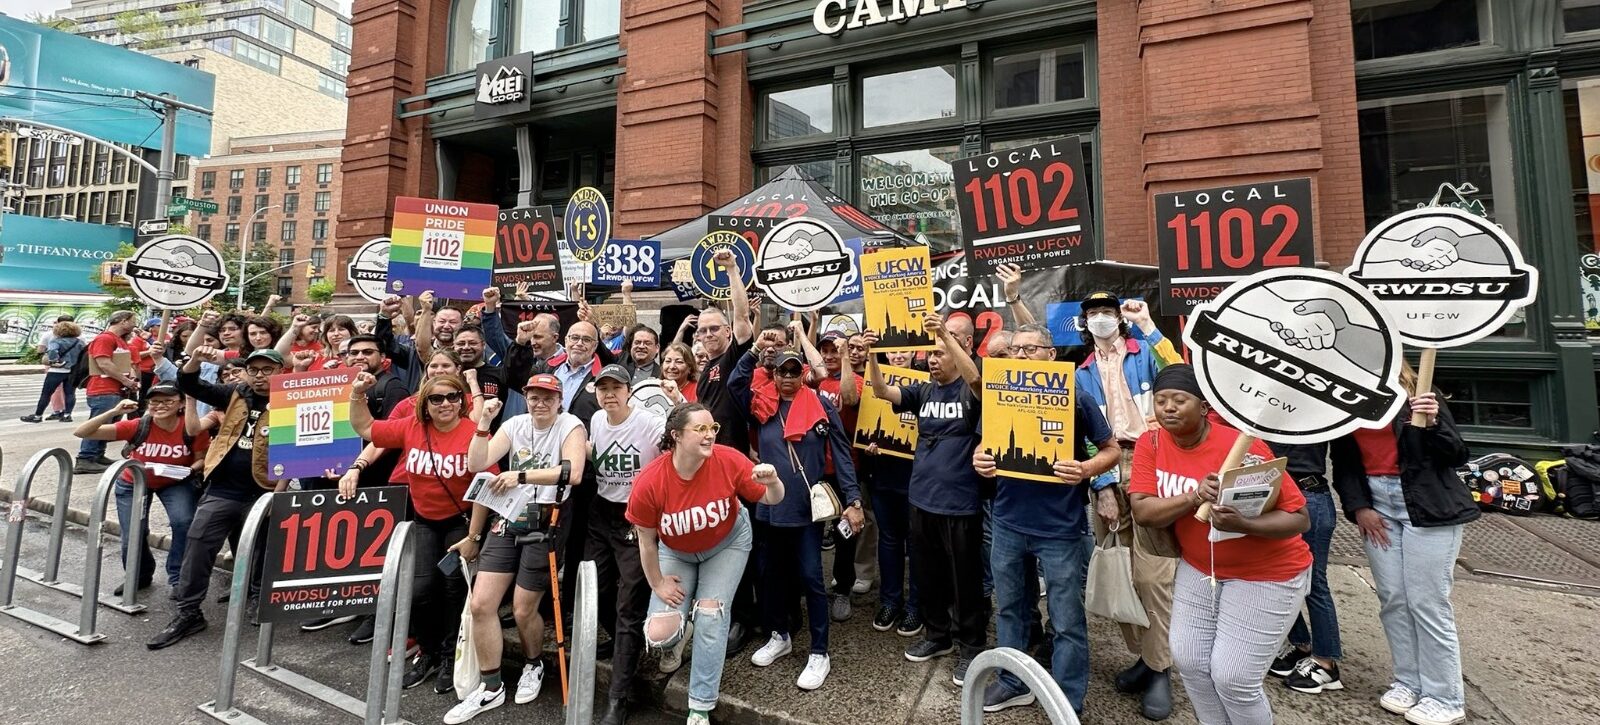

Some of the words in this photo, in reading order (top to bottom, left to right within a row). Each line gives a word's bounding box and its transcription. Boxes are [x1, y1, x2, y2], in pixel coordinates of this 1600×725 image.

[813, 0, 967, 35] CAM
[492, 74, 523, 96] REI
[29, 128, 75, 145] SKYLINE
[968, 144, 1062, 173] LOCAL
[862, 173, 936, 191] WELCOME
[573, 188, 600, 205] RWDSU
[743, 193, 809, 205] LOCAL
[870, 194, 897, 207] THE
[902, 188, 950, 204] CO-OP
[964, 161, 1079, 233] 1102
[1174, 184, 1287, 208] LOCAL
[425, 203, 469, 217] UNION
[499, 209, 542, 221] OCAL
[578, 201, 594, 211] LOCAL
[425, 217, 466, 231] PRIDE
[574, 213, 597, 241] 1-S
[718, 217, 776, 229] LOCAL
[428, 231, 459, 239] LOCAL
[701, 233, 739, 251] RWDSU
[1167, 204, 1300, 271] 1102
[425, 237, 461, 258] 1102
[575, 248, 596, 261] UFCW
[974, 242, 1027, 261] RWDSU
[1036, 234, 1083, 252] UFCW
[597, 246, 606, 281] LOCA
[606, 243, 655, 276] 338
[877, 256, 924, 275] UFCW
[987, 254, 1025, 266] ORGANIZE
[1026, 252, 1042, 261] FOR
[1043, 249, 1071, 258] POWER
[136, 268, 217, 287] RWDSU
[355, 271, 388, 281] RWD
[494, 271, 526, 284] RWDSU
[531, 271, 557, 281] UFCW
[705, 257, 728, 282] 1-
[766, 262, 842, 282] RWDSU
[156, 287, 188, 297] UFCW
[790, 285, 820, 295] UFCW
[873, 281, 899, 290] Local
[902, 276, 928, 288] 1500
[1170, 285, 1224, 299] RWDS
[1366, 281, 1511, 296] RWDSU
[711, 288, 732, 299] UFC
[933, 283, 1007, 313] OCAL
[519, 303, 557, 311] LOCAL
[1405, 312, 1461, 321] UFCW
[1207, 331, 1369, 406] RWDSU
[282, 374, 349, 389] CELEBRATING
[1005, 369, 1068, 389] UFCW
[286, 387, 345, 401] SOLIDARITY
[998, 391, 1032, 405] Local
[1034, 394, 1070, 408] 1500
[1238, 382, 1298, 414] UFCW
[301, 404, 329, 412] LOCAL
[299, 411, 331, 433] 1102
[405, 447, 469, 480] RWDSU
[604, 453, 641, 472] REI
[1155, 469, 1199, 499] RWD
[291, 490, 388, 508] LOCAL
[660, 497, 731, 537] RWDSU
[280, 508, 395, 573] 1102
[270, 587, 330, 604] RWDSU
[283, 602, 326, 612] ORGANIZE
[327, 600, 344, 608] FOR
[345, 597, 374, 605] POWER
